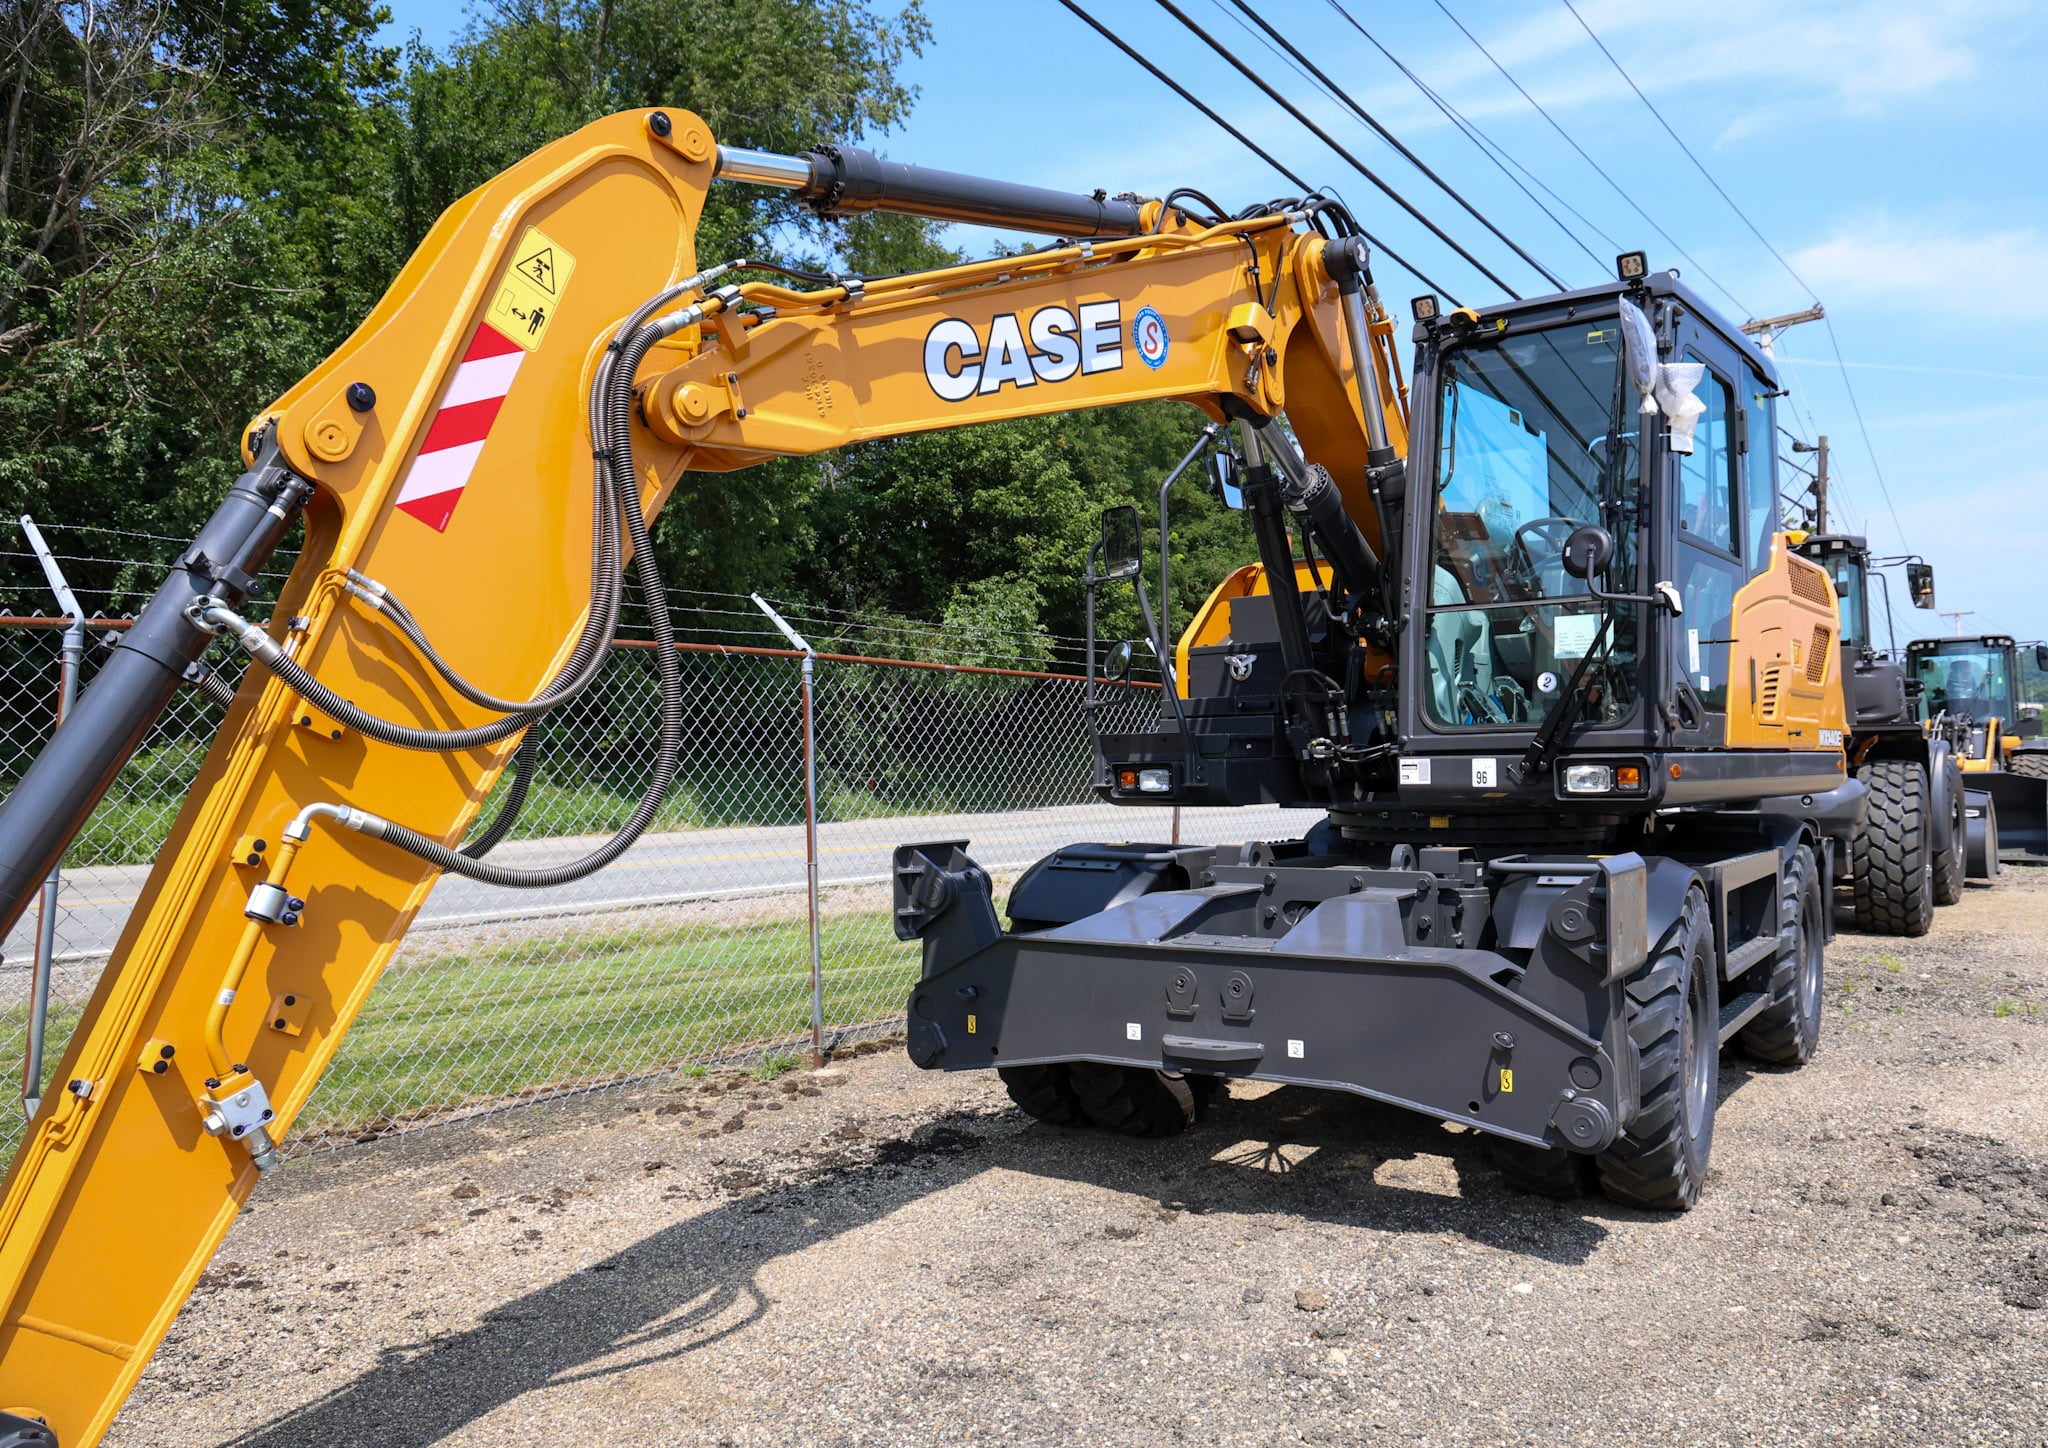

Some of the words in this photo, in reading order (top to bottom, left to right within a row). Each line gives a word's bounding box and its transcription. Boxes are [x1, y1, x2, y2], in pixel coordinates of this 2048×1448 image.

[1145, 321, 1158, 354] S
[923, 299, 1123, 402] CASE
[1543, 676, 1552, 688] 2
[1476, 770, 1488, 784] 96
